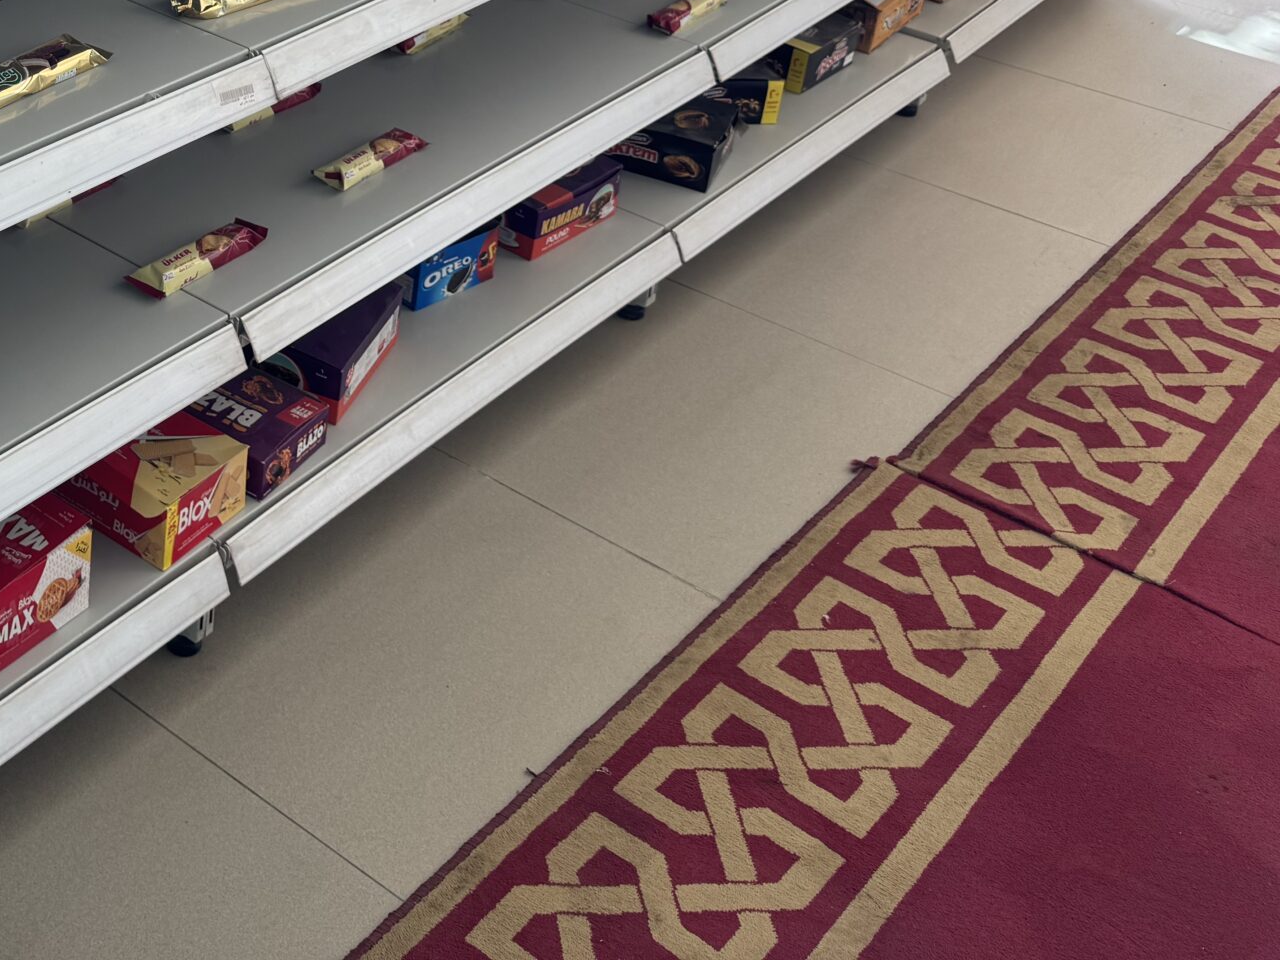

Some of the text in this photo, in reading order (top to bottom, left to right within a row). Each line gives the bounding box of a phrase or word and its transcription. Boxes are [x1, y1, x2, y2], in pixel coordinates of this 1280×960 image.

[344, 148, 369, 166] ÜLKER
[540, 203, 586, 235] KAMARA
[161, 248, 192, 267] ÜLKER
[423, 255, 472, 289] OREO
[296, 422, 326, 458] BLAZO
[112, 519, 139, 543] Blox
[177, 495, 214, 535] Blox
